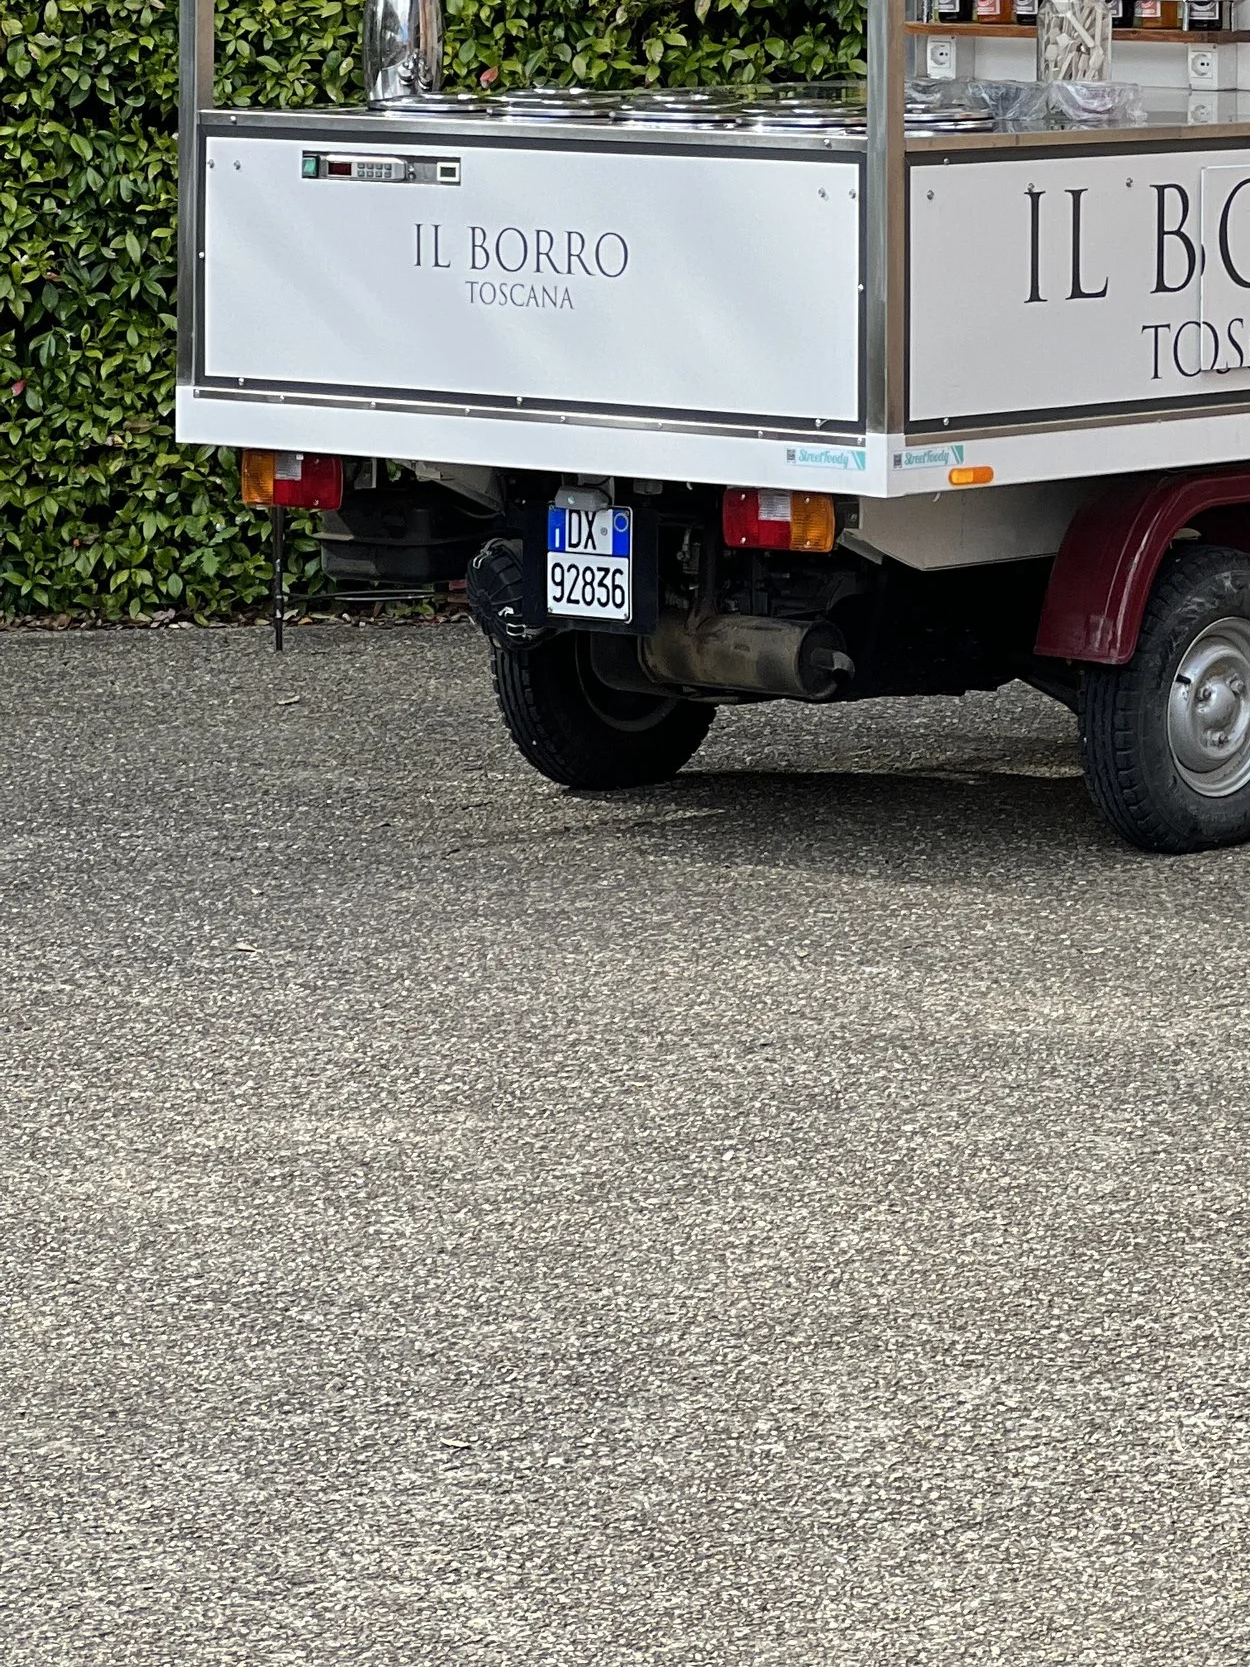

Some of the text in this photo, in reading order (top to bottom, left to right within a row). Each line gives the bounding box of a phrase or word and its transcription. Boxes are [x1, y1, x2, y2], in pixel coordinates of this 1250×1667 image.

[414, 223, 629, 278] IL BORRO
[1024, 188, 1109, 303] IL
[465, 281, 575, 310] TOSCANA
[568, 509, 597, 550] DX
[551, 562, 625, 609] 92836
